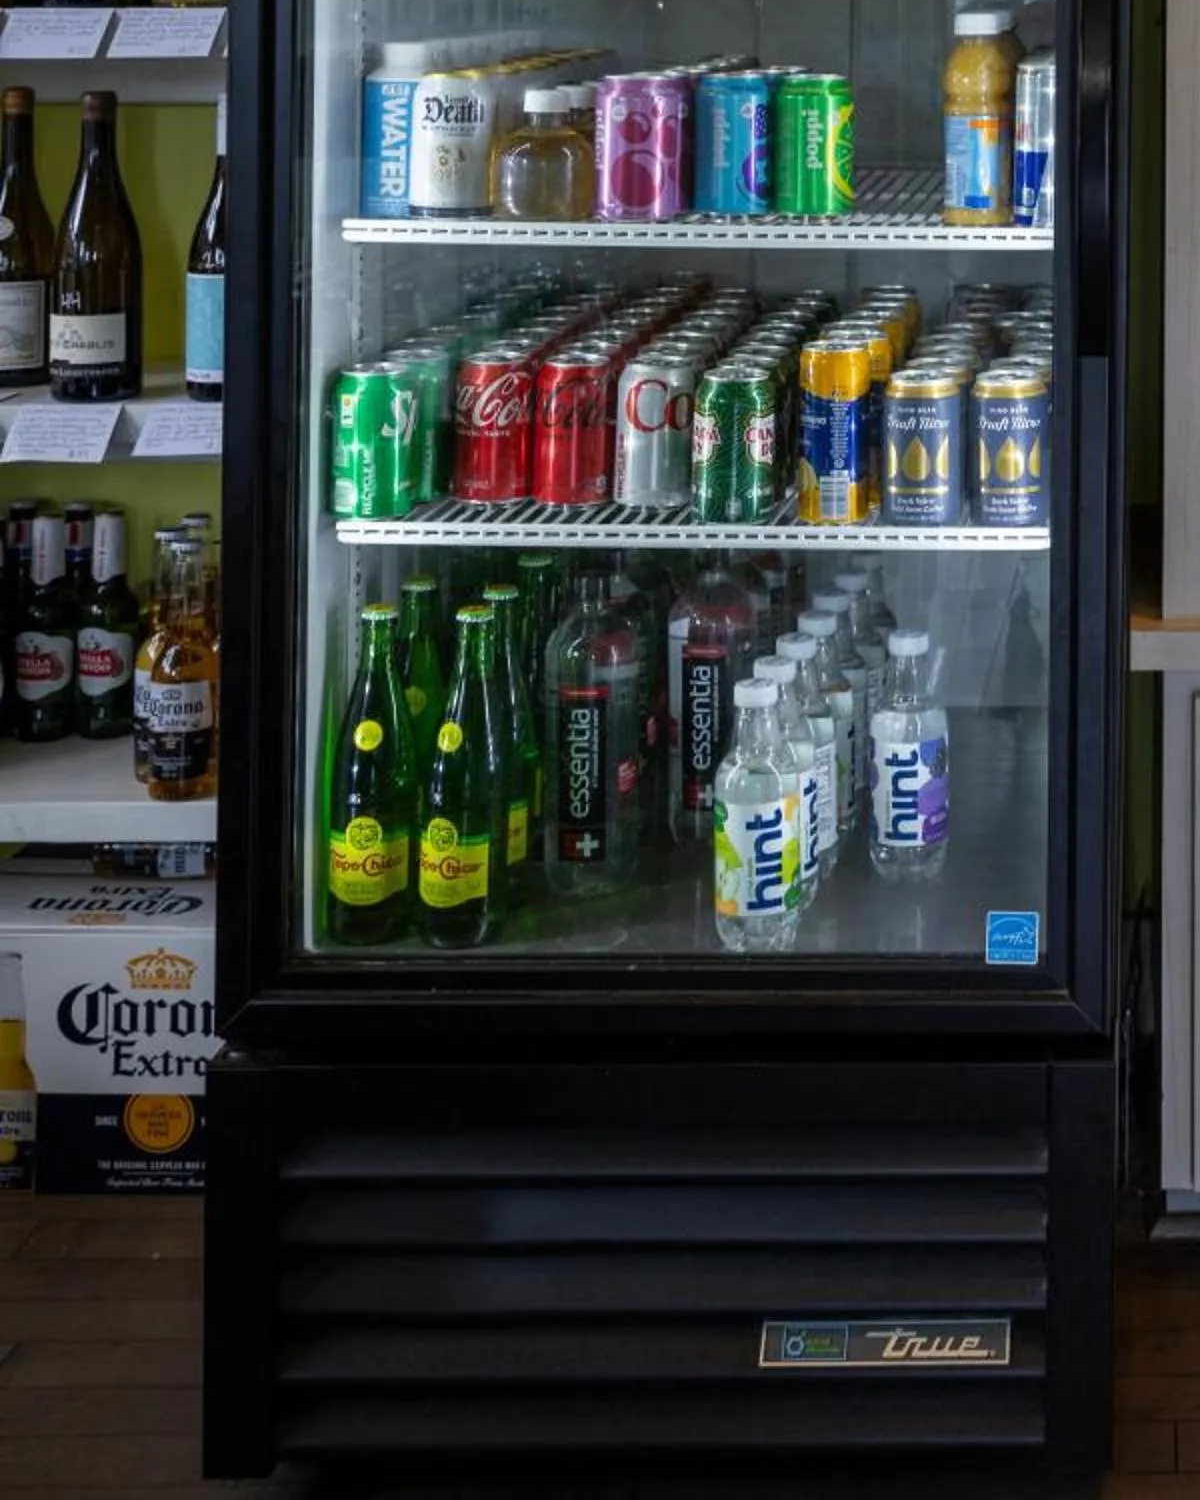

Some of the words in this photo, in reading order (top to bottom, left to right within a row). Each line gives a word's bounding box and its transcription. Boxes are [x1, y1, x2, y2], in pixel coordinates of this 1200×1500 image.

[380, 100, 408, 198] WATER
[422, 95, 486, 125] Death
[801, 107, 824, 170] poppi
[625, 379, 693, 432] Co
[150, 698, 204, 717] Corona
[691, 663, 714, 771] essentia
[569, 707, 592, 819] essentia
[885, 747, 920, 842] hint
[745, 807, 784, 912] hint
